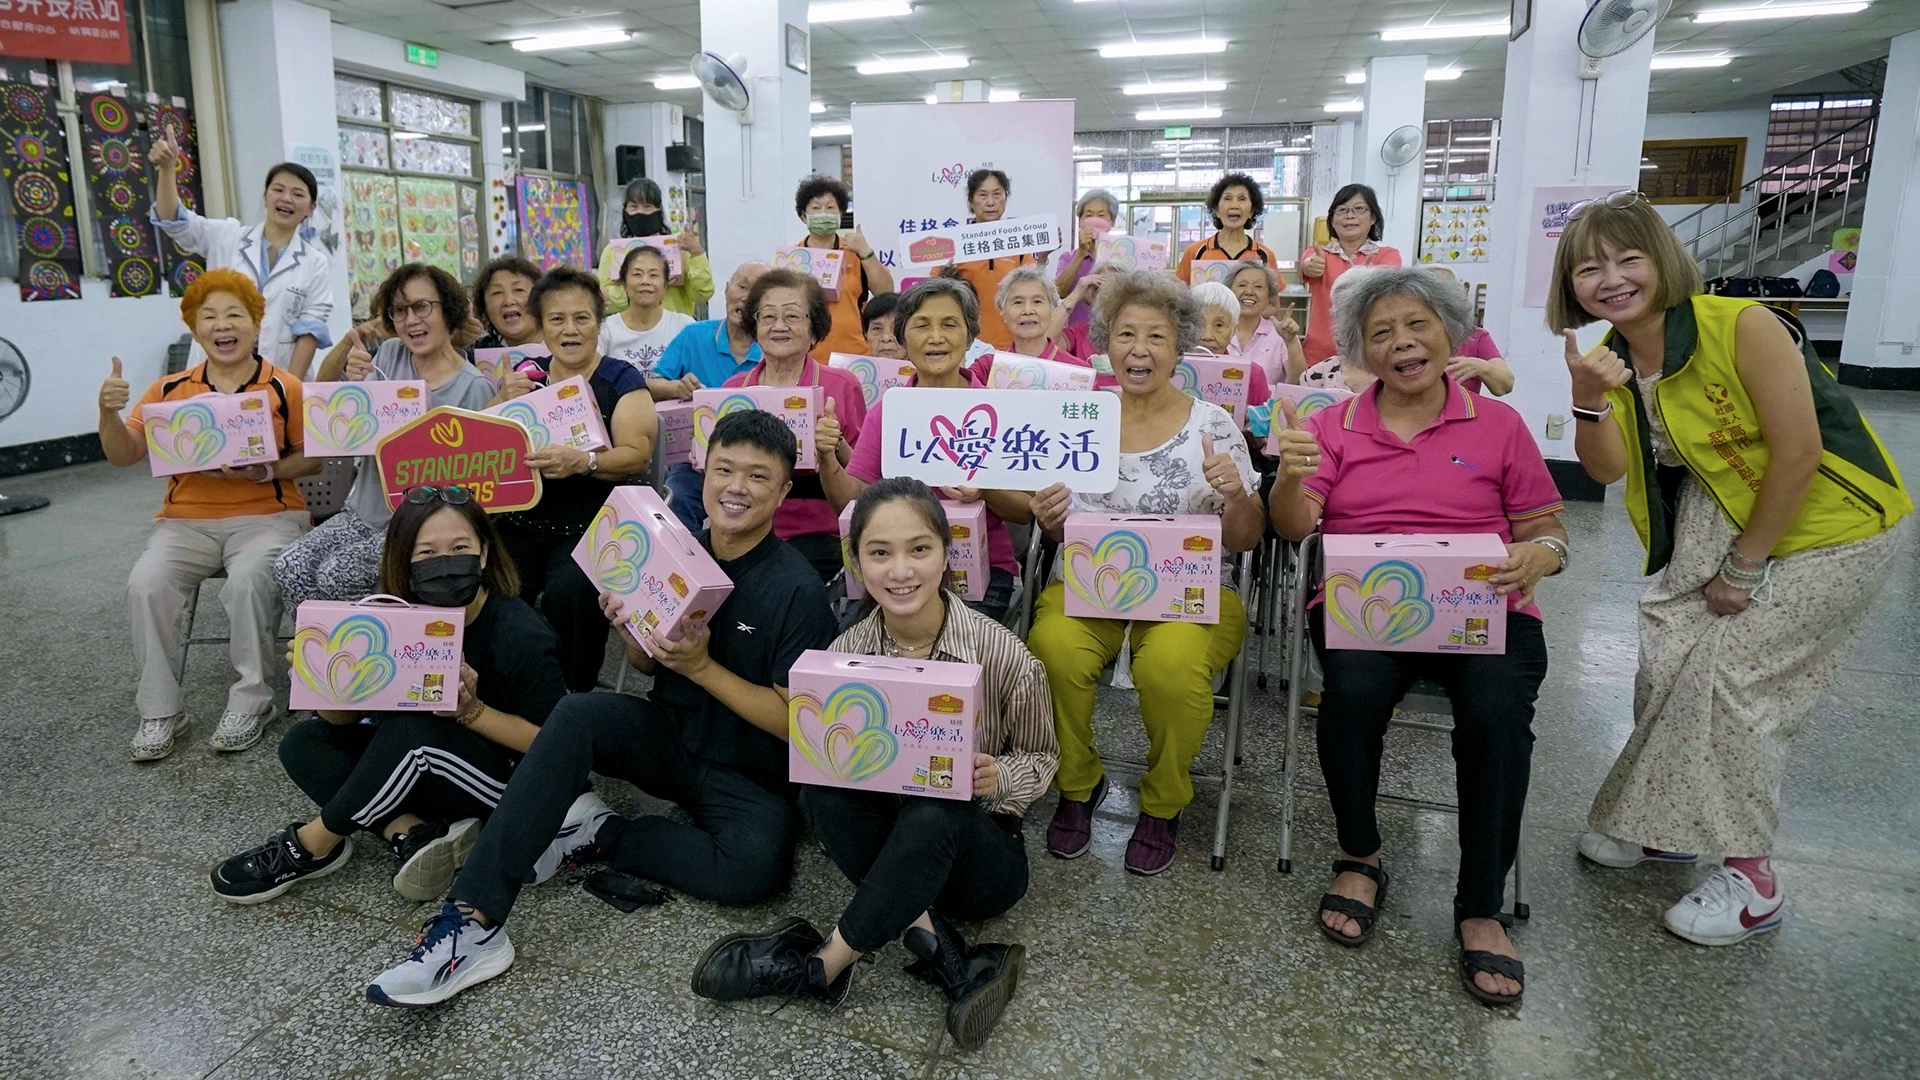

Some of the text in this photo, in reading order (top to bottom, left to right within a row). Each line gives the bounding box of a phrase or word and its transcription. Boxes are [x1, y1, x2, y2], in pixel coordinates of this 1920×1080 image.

[961, 221, 1048, 240] Standard Foods Group
[962, 231, 1050, 256] 佳格食品集團
[1062, 402, 1099, 420] 桂格
[900, 419, 1101, 473] 以愛樂活
[395, 448, 517, 485] STANDARD
